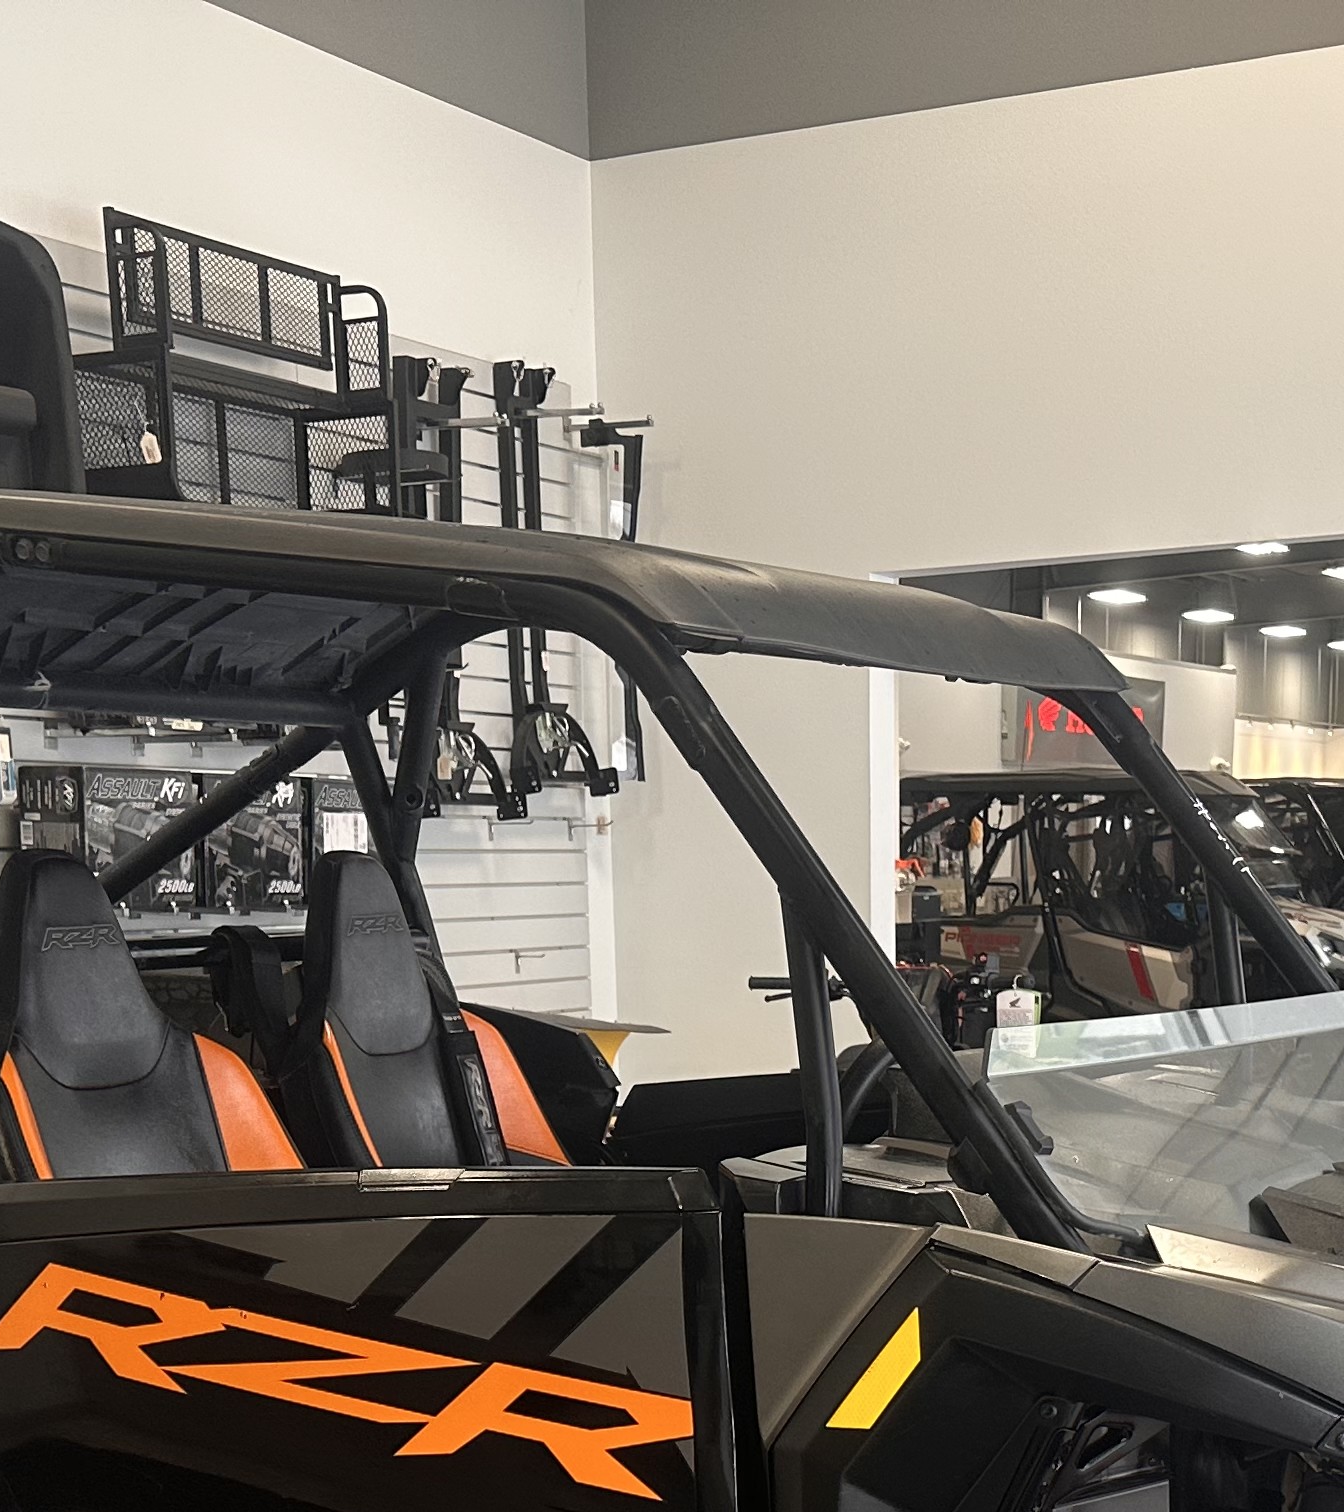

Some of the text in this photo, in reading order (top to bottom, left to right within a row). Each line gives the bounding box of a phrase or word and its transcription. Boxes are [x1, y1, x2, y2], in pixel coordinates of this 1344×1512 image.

[86, 773, 161, 799] ASSAULT
[315, 784, 363, 809] ASSAU
[347, 912, 405, 937] RZR
[41, 923, 121, 952] RZR
